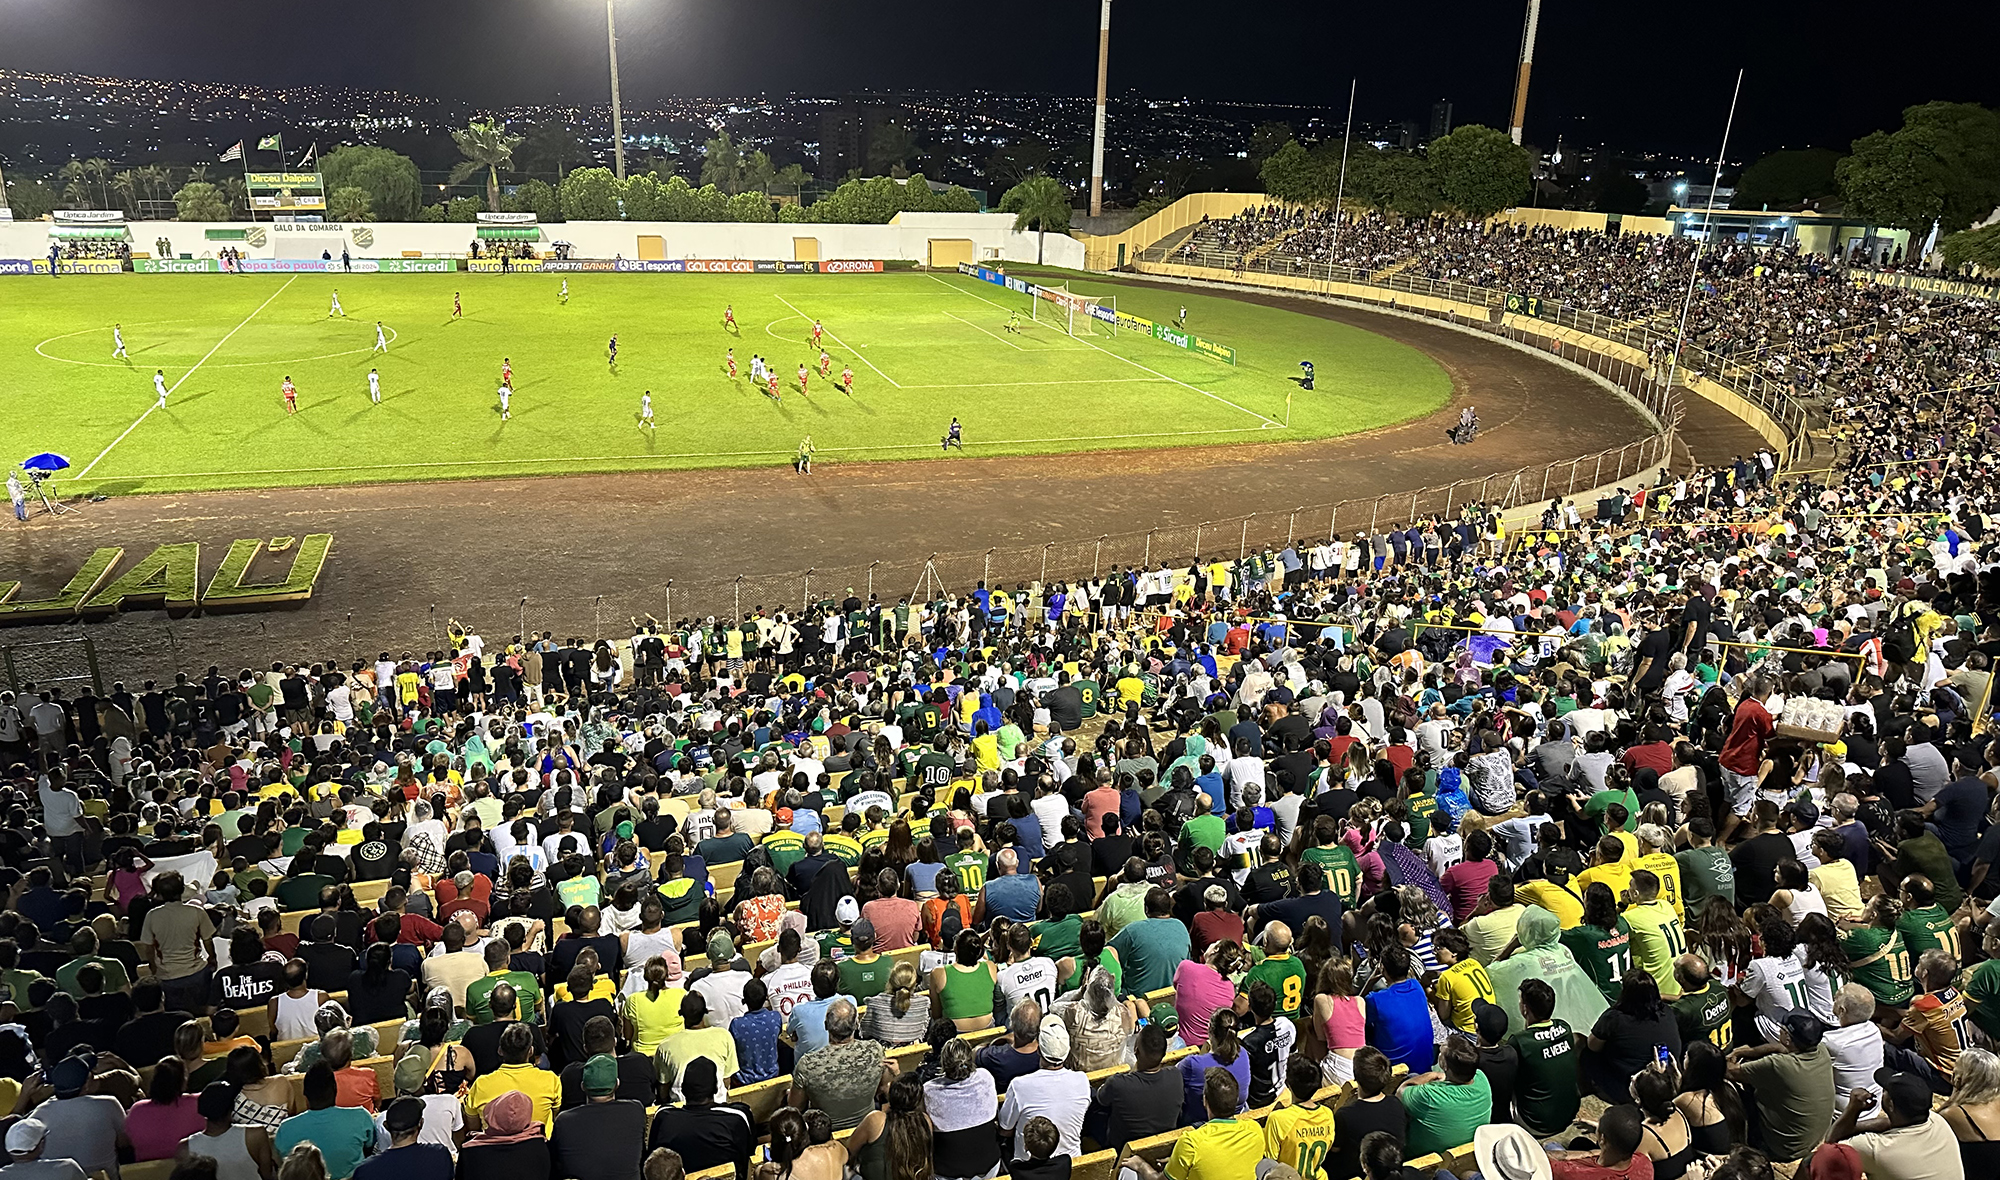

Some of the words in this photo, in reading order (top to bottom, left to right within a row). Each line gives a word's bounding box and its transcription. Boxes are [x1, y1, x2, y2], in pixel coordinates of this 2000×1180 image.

[251, 174, 280, 182] Dirceu
[282, 174, 316, 184] Dalpino
[160, 260, 208, 272] Sicredi
[242, 262, 268, 272] opa
[271, 260, 290, 269] são
[294, 260, 325, 272] paulo
[402, 260, 448, 272] Sicredi
[470, 263, 542, 272] euroarma
[630, 260, 682, 272] BETesporte
[687, 262, 708, 272] GOL
[709, 262, 730, 272] GOL
[731, 262, 751, 272] GOL
[843, 262, 875, 270] KRONA
[1116, 316, 1152, 336] eurofarma
[1163, 326, 1188, 348] Sicredi
[1544, 643, 1550, 656] 6
[406, 681, 414, 693] 10
[1082, 688, 1093, 704] 8
[925, 711, 936, 728] 9
[925, 764, 949, 784] 10
[959, 865, 983, 890] 10
[1324, 868, 1351, 896] 10
[1659, 920, 1687, 958] 10
[1933, 926, 1962, 960] 10
[1607, 948, 1630, 982] 11
[1885, 951, 1912, 981] 10
[239, 975, 252, 985] THE
[1017, 970, 1043, 984] Dener
[1463, 969, 1492, 998] 10
[222, 975, 274, 1000] BEATLES
[784, 980, 811, 991] PHILLIPS
[1282, 974, 1301, 1012] 8
[1705, 998, 1727, 1020] Dener
[1534, 1026, 1566, 1040] crefisa
[1709, 1019, 1733, 1050] 10
[1296, 1126, 1324, 1138] NEYMAR
[1298, 1140, 1327, 1180] 10
